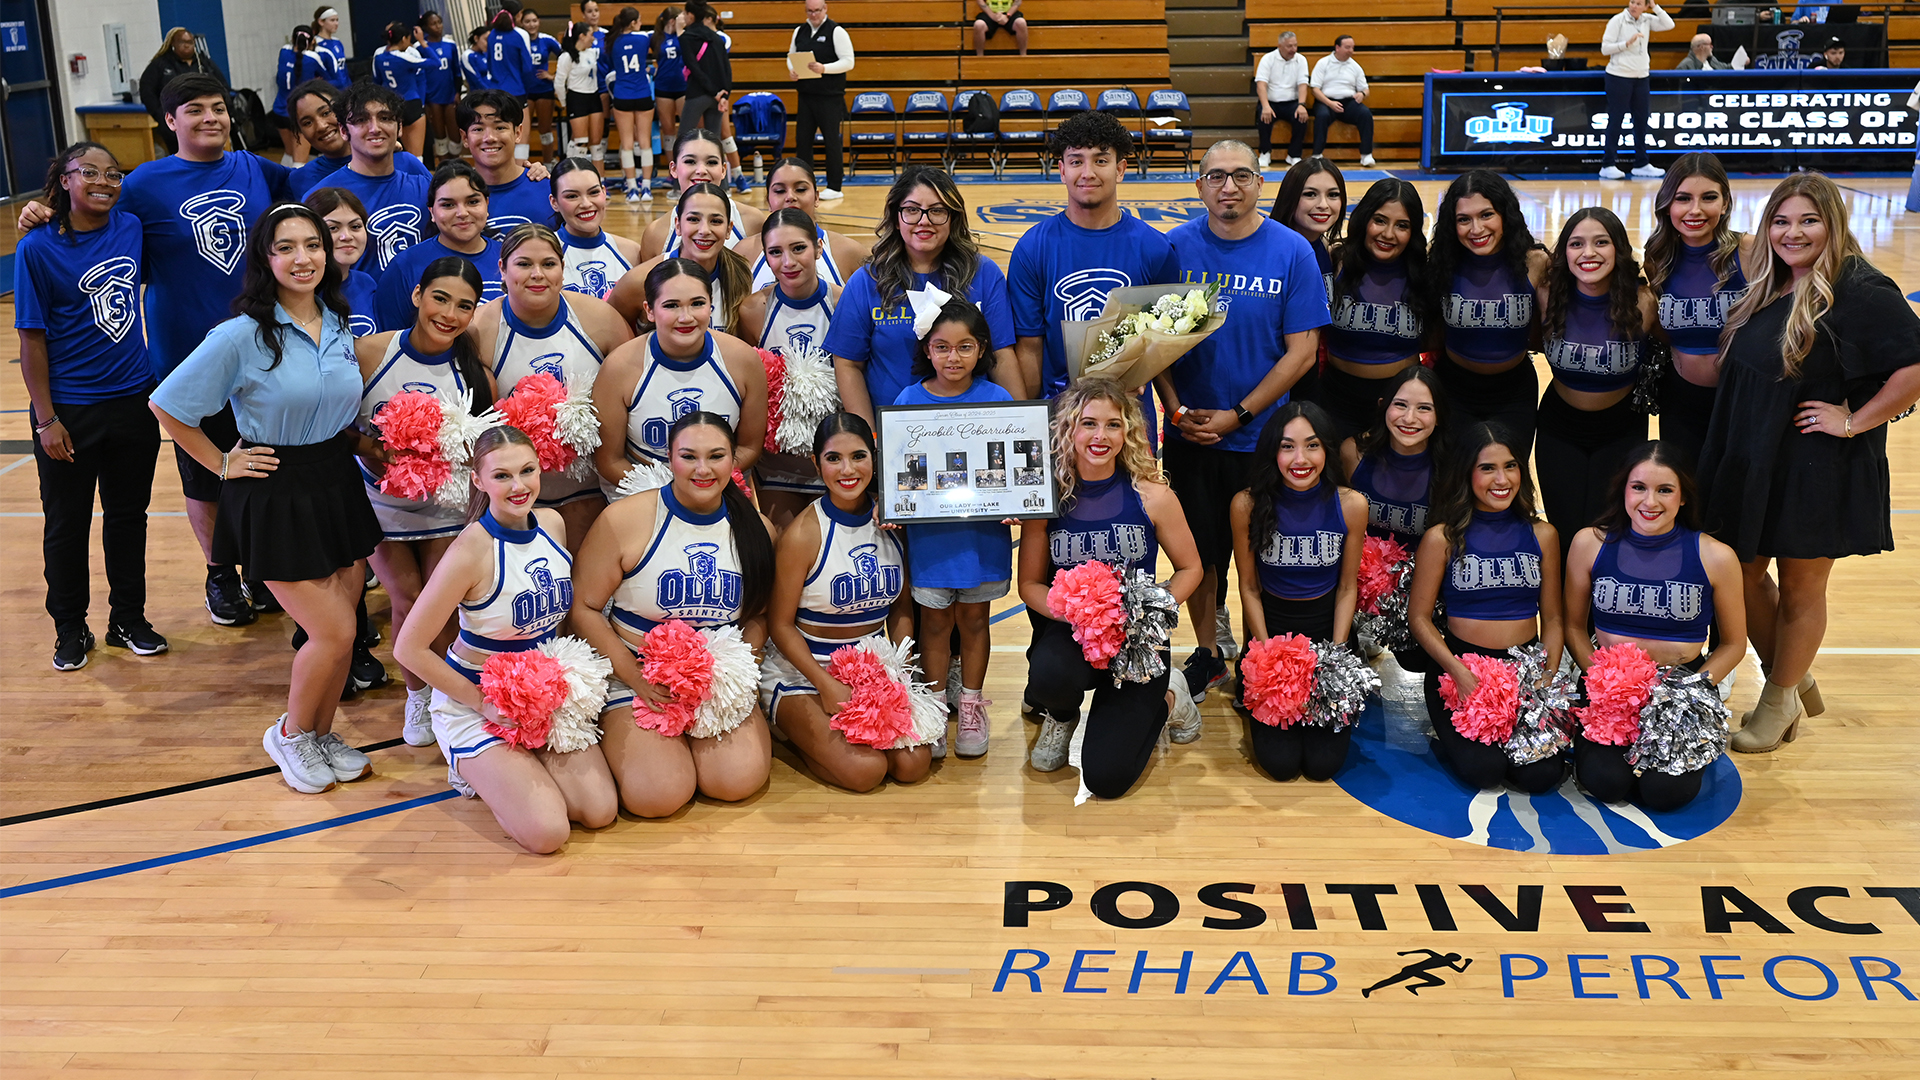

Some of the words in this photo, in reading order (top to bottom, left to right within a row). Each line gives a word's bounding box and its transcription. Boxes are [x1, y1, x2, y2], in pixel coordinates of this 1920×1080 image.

[493, 42, 504, 61] 8
[665, 47, 677, 60] 15
[621, 53, 640, 74] 14
[285, 71, 292, 90] 1
[384, 70, 398, 89] 5
[858, 94, 887, 104] SAINTS
[911, 93, 941, 104] SAINTS
[1005, 92, 1035, 103] SAINTS
[1053, 92, 1083, 103] SAINTS
[1103, 91, 1133, 102] SAINTS
[1153, 91, 1183, 102] SAINTS
[1708, 93, 1892, 108] CELEBRATING
[1465, 114, 1554, 138] OLLU
[1739, 111, 1850, 129] CLASS
[1859, 110, 1909, 128] OF
[1673, 132, 1782, 147] CAMILA,
[1788, 132, 1853, 146] TINA
[1858, 131, 1916, 145] AND
[1178, 269, 1282, 295] LLUDAD
[1330, 295, 1423, 339] OLLU
[1442, 293, 1533, 329] OLLU
[1542, 332, 1641, 375] OLLU
[906, 424, 955, 448] Ginobili
[956, 422, 1027, 440] Cobarrubias
[894, 502, 917, 513] OLLU
[1023, 498, 1046, 508] OLLU
[1356, 491, 1429, 536] LL
[1050, 523, 1148, 567] OLLU
[1259, 529, 1344, 567] OLLU
[1451, 551, 1541, 592] OLLU
[657, 567, 744, 612] OLLU
[829, 564, 900, 608] OLLU
[511, 577, 574, 629] OLLU
[850, 600, 886, 610] SAINTS
[1592, 577, 1705, 622] OLLU
[530, 613, 566, 631] SAINTS
[678, 609, 723, 618] SAINTS
[1002, 880, 1652, 933] POSITIVE
[992, 948, 1339, 997] REHAB
[1499, 953, 1920, 1002] PERFOR
